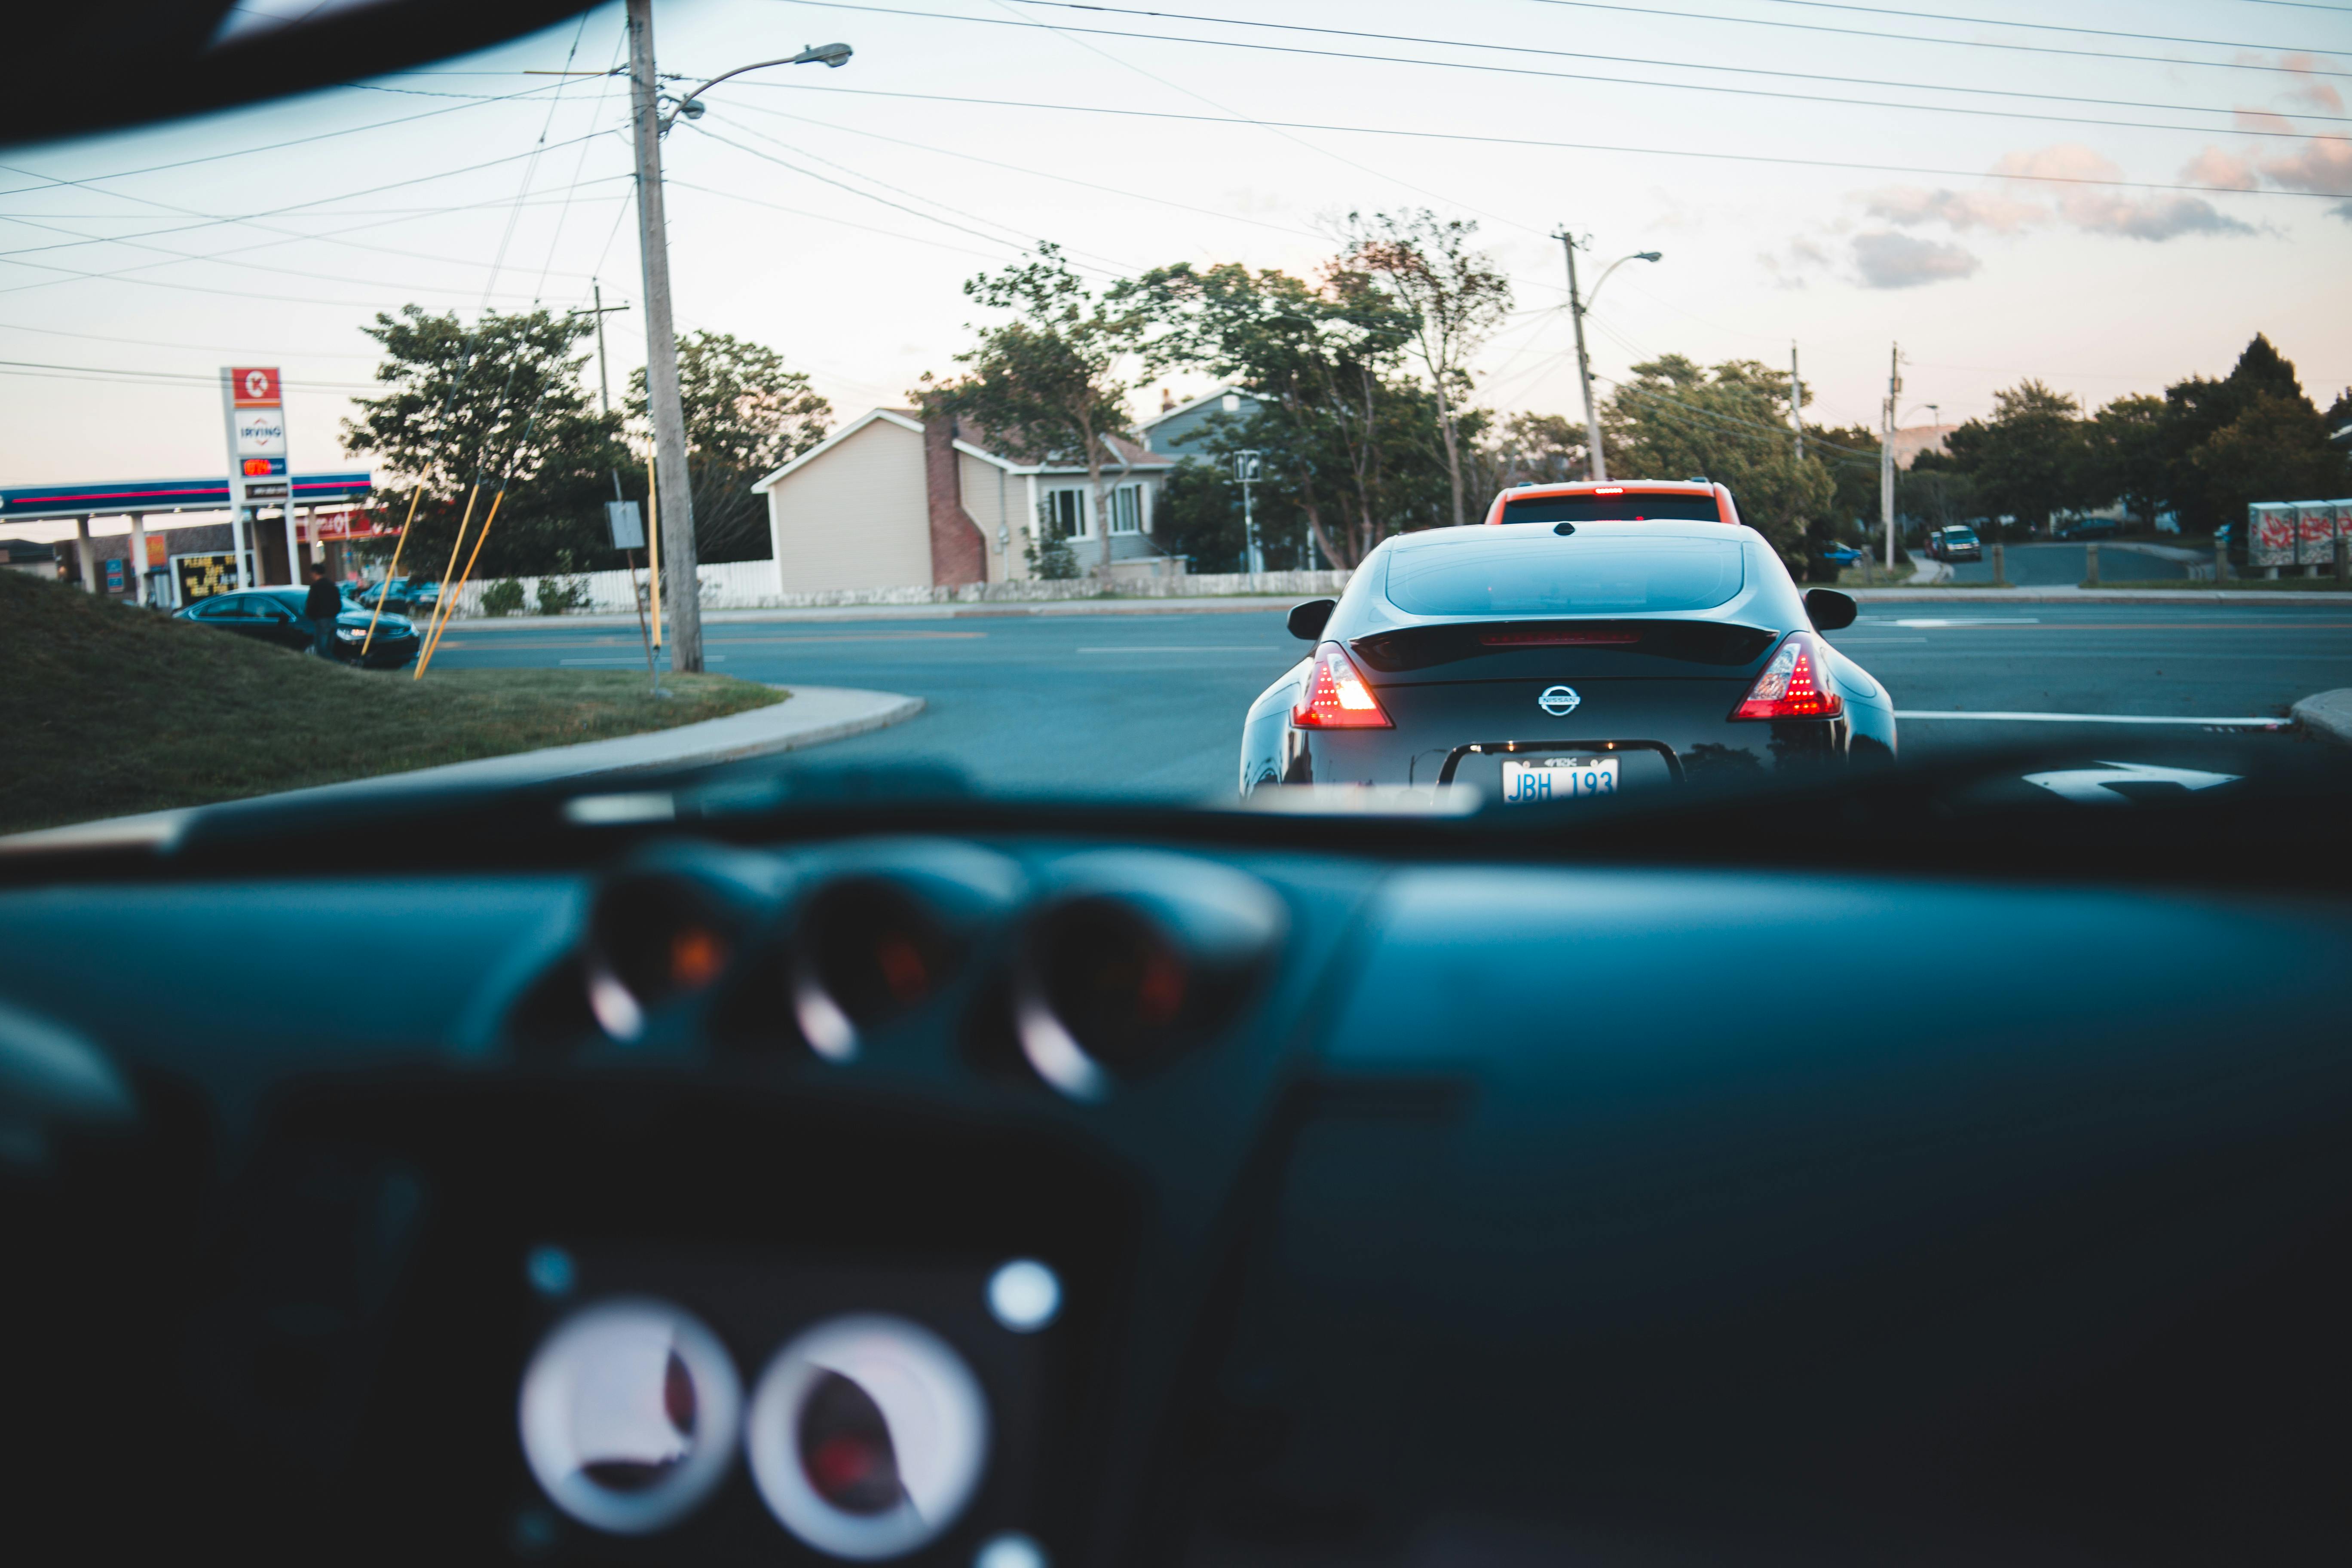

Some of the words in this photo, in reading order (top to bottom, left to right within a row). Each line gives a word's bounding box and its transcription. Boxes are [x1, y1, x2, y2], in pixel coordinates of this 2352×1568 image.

[241, 427, 281, 437] IRVING
[1508, 773, 1553, 801] JBH
[1571, 772, 1613, 798] 193
